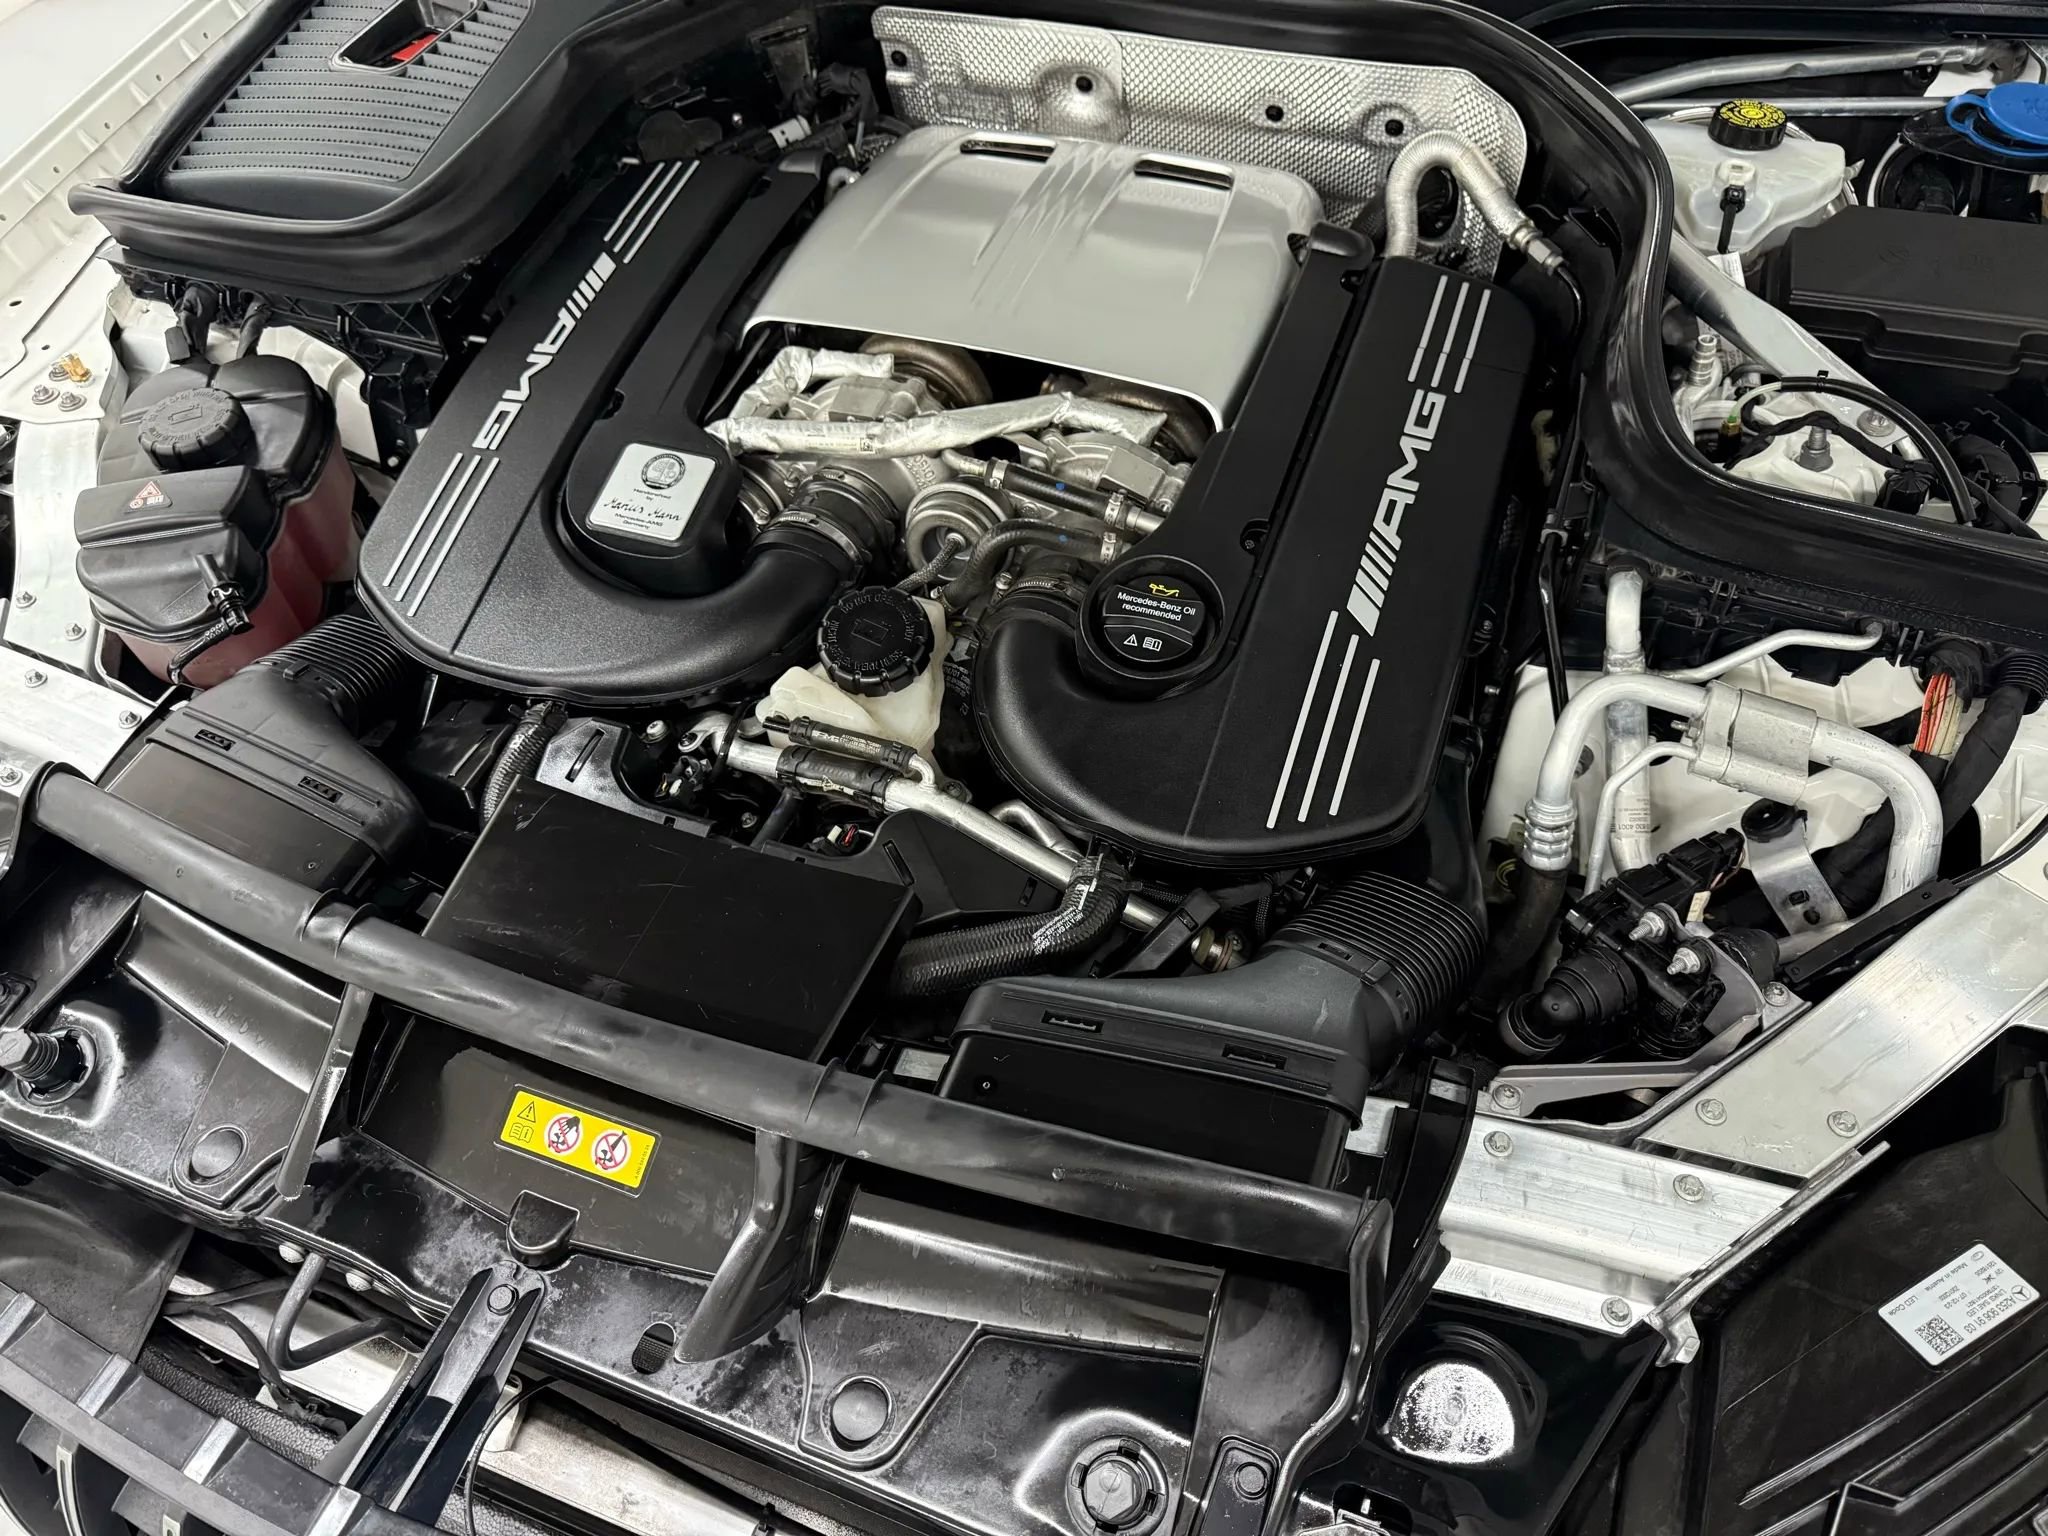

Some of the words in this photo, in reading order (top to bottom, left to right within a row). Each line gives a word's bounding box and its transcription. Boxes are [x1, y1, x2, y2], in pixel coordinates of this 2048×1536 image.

[472, 307, 576, 450] AMG
[1373, 388, 1447, 552] AMG
[614, 512, 663, 527] Mercedes-AMG
[1117, 592, 1181, 613] Mercedes-Benz
[1183, 606, 1196, 616] Oil
[1122, 602, 1182, 621] recommended
[1950, 1261, 1969, 1275] Made
[1924, 1276, 1946, 1292] Austria
[1905, 1295, 1919, 1307] LED
[1997, 1295, 2017, 1313] A253
[1887, 1303, 1907, 1317] Code
[1966, 1305, 1979, 1317] LED
[1985, 1306, 2000, 1322] 906
[1963, 1321, 1977, 1334] 03
[1975, 1316, 1986, 1328] 91
